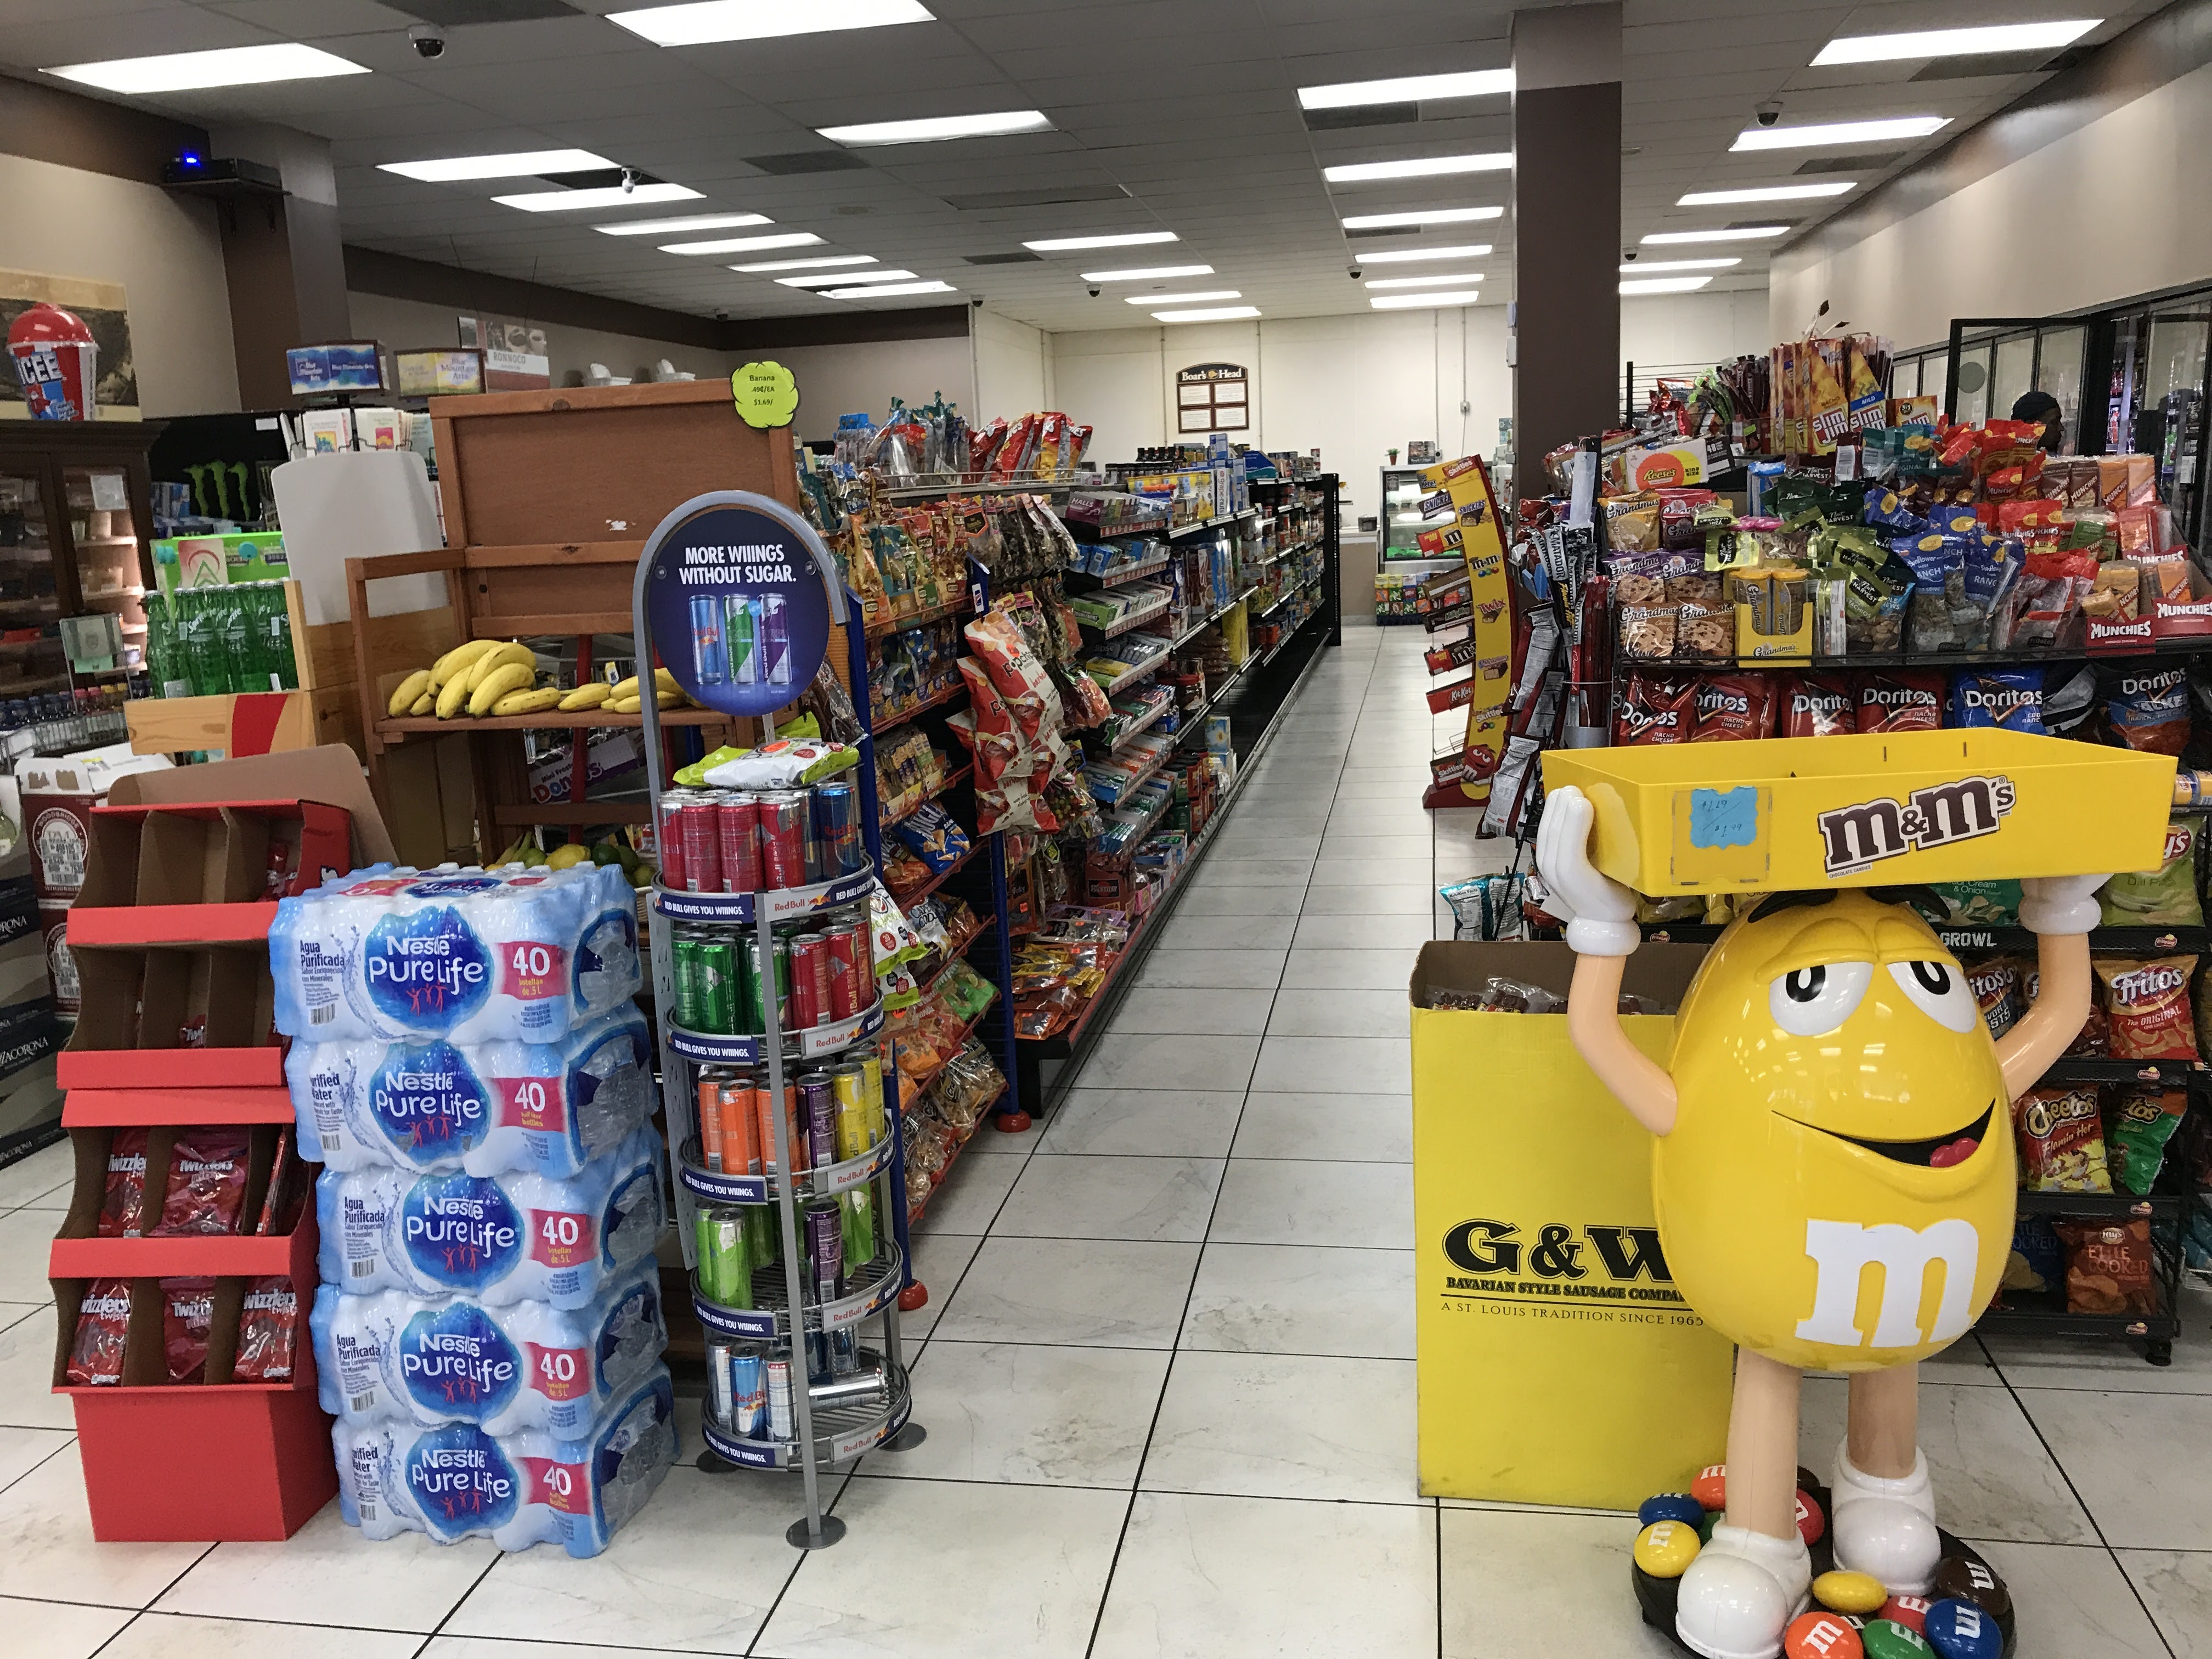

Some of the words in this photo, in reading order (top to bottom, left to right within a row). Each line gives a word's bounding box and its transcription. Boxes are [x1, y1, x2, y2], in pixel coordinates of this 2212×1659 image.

[493, 352, 526, 364] RONNOCO
[1182, 371, 1206, 381] Boar's
[1218, 368, 1242, 379] Head
[1644, 469, 1677, 481] Reese's
[1071, 497, 1094, 508] HALLS
[1425, 493, 1452, 512] SNICKER
[1459, 500, 1486, 515] SNICKERS
[685, 547, 725, 565] MORE
[727, 544, 785, 563] WIIINGS
[1550, 534, 1564, 579] MATADOR
[679, 567, 741, 585] WITHOUT
[746, 565, 797, 583] SUGAR.
[1853, 582, 1877, 602] HARVEST
[1479, 599, 1506, 614] Twix
[2091, 620, 2151, 639] MUNCHIES
[1753, 644, 1796, 657] Grandma's
[1863, 687, 1937, 706] Doritos
[1966, 690, 2042, 707] Doritos
[1829, 869, 1853, 878] CHOCOLATE
[836, 891, 846, 901] RED
[847, 887, 856, 898] BULL
[1961, 886, 1987, 894] Onion
[673, 903, 684, 912] BULL
[684, 905, 699, 915] GIVES
[700, 906, 713, 915] YOU
[775, 903, 789, 911] Red
[791, 899, 805, 909] Bull
[300, 940, 320, 955] Agua
[1940, 933, 1997, 946] GROWL
[301, 953, 345, 967] Purificada
[513, 947, 550, 976] 40
[369, 957, 434, 984] Pure
[438, 957, 483, 995] Life
[2111, 969, 2184, 1004] Fritos
[2140, 1005, 2182, 1026] ORIGINAL
[816, 1038, 831, 1047] Red
[832, 1034, 844, 1044] Bull
[692, 1045, 707, 1055] GIVES
[707, 1047, 720, 1056] YOU
[310, 1073, 340, 1087] urified
[515, 1082, 546, 1111] 40
[376, 1089, 437, 1118] Pure
[442, 1093, 481, 1126] Life
[2026, 1091, 2096, 1138] Cheetos
[2077, 1124, 2094, 1137] Hot
[837, 1174, 851, 1184] Red
[852, 1169, 865, 1181] Bull
[701, 1182, 714, 1192] GIVES
[714, 1185, 726, 1194] YOU
[345, 1197, 363, 1211] Agua
[345, 1210, 385, 1224] Purificada
[407, 1216, 467, 1242] Pure
[470, 1220, 515, 1258] Life
[543, 1216, 578, 1245] 40
[1446, 1277, 1516, 1293] BAVARIAN
[1518, 1282, 1561, 1296] STYLE
[1563, 1285, 1626, 1299] SAUSAGE
[1628, 1288, 1686, 1302] COMPA
[1795, 1218, 1979, 1347] m
[833, 1311, 848, 1322] Red
[849, 1306, 862, 1318] Bull
[1441, 1302, 1451, 1311] A
[1457, 1303, 1475, 1313] ST.
[1481, 1306, 1525, 1317] LOUIS
[1532, 1308, 1613, 1322] TRADITION
[1620, 1313, 1664, 1324] SINCE
[712, 1315, 724, 1326] GIVES
[725, 1320, 737, 1329] YOU
[337, 1334, 356, 1347] Agua
[338, 1345, 381, 1359] Purificada
[403, 1353, 466, 1377] Pure
[469, 1357, 513, 1393] Life
[540, 1353, 575, 1381] 40
[733, 1391, 754, 1403] Red
[718, 1442, 729, 1454] GIVES
[730, 1448, 741, 1458] YOU
[843, 1442, 857, 1453] Red
[858, 1437, 872, 1449] Bull
[413, 1464, 469, 1493] Pure
[475, 1472, 510, 1504] Life
[543, 1466, 571, 1496] 40
[1804, 1620, 1844, 1654] m
